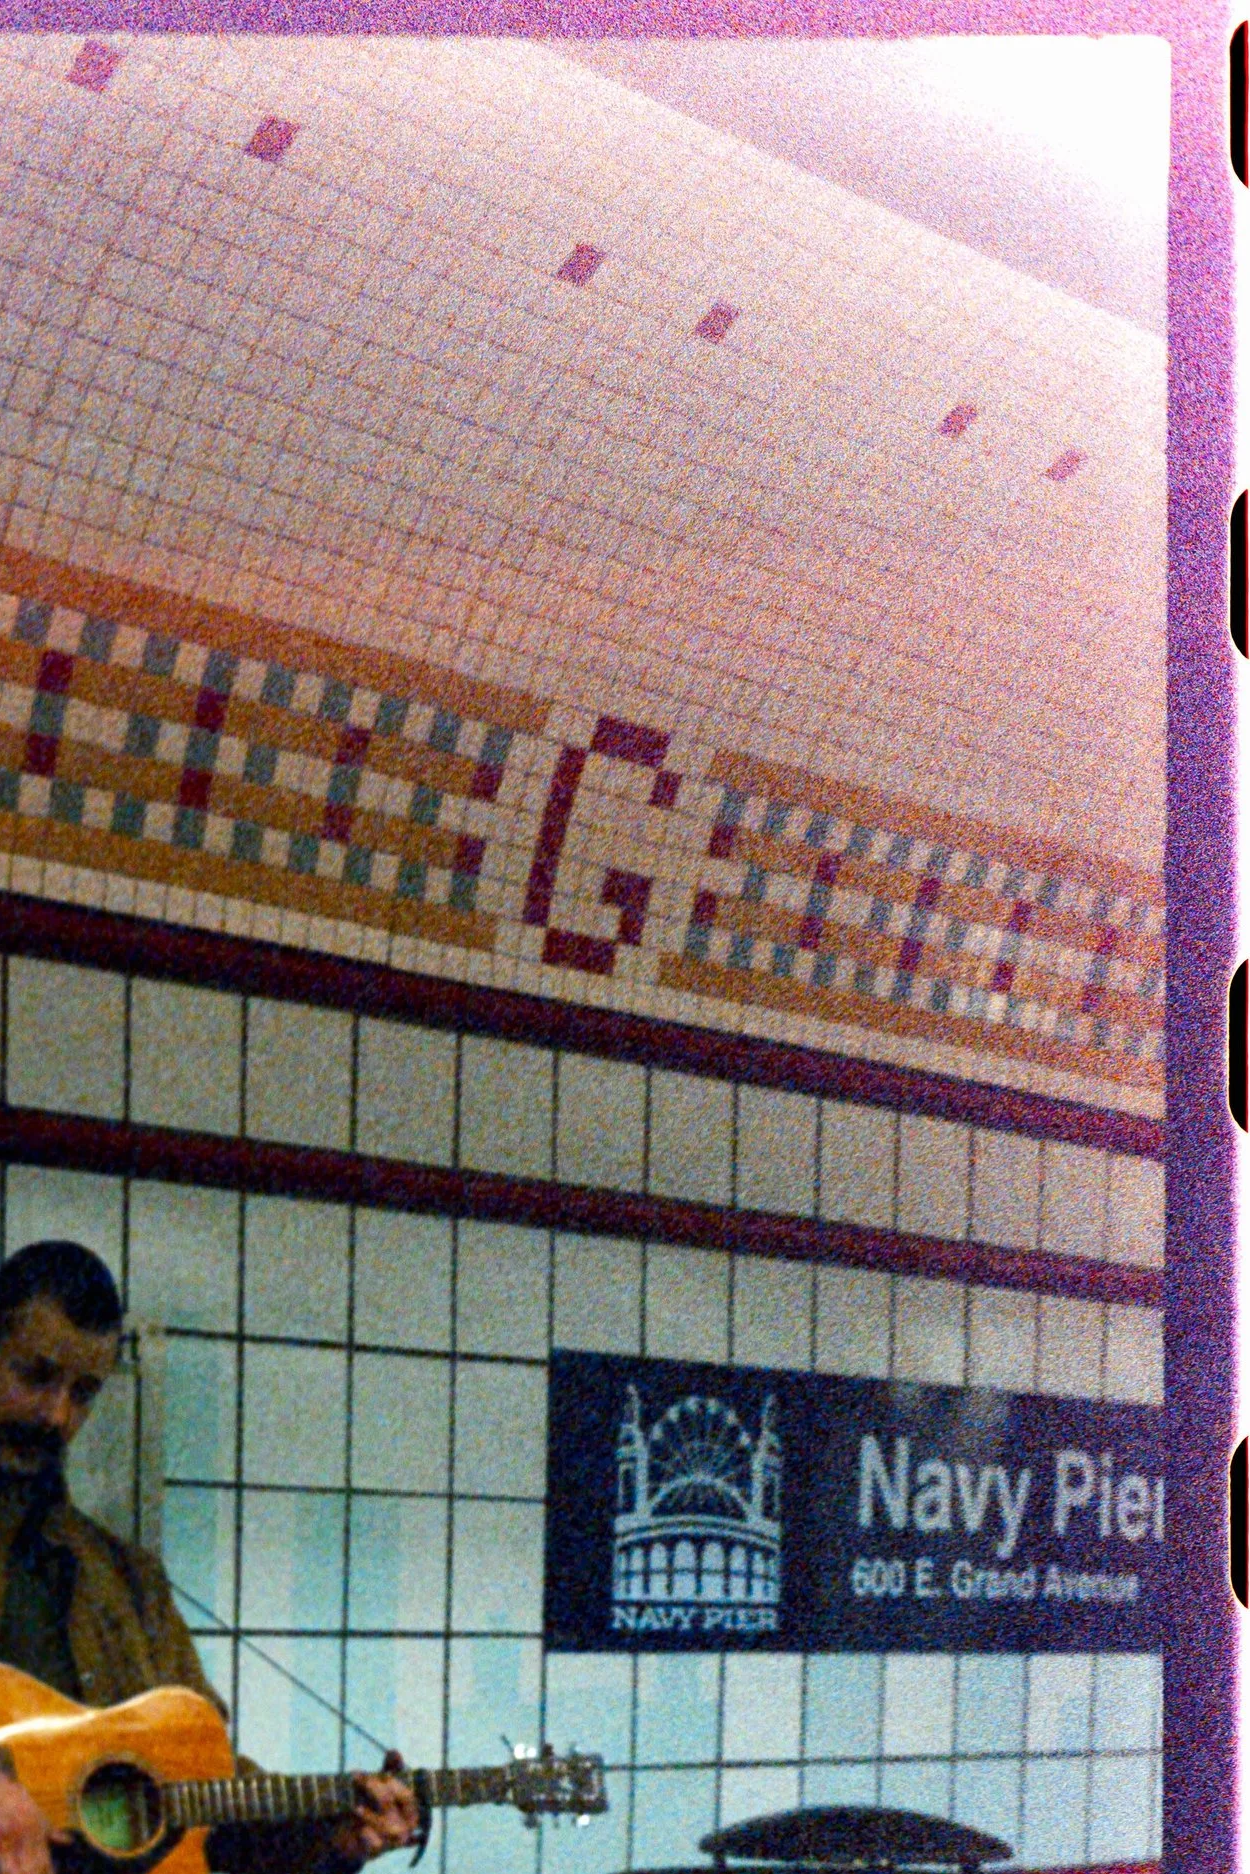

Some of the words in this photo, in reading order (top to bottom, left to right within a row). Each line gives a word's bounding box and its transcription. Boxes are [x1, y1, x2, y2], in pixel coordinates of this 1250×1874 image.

[858, 1434, 1032, 1558] Navy
[851, 1556, 905, 1598] 600
[951, 1560, 1037, 1602] Grand
[611, 1606, 695, 1633] NAVY
[702, 1606, 779, 1633] PIER
